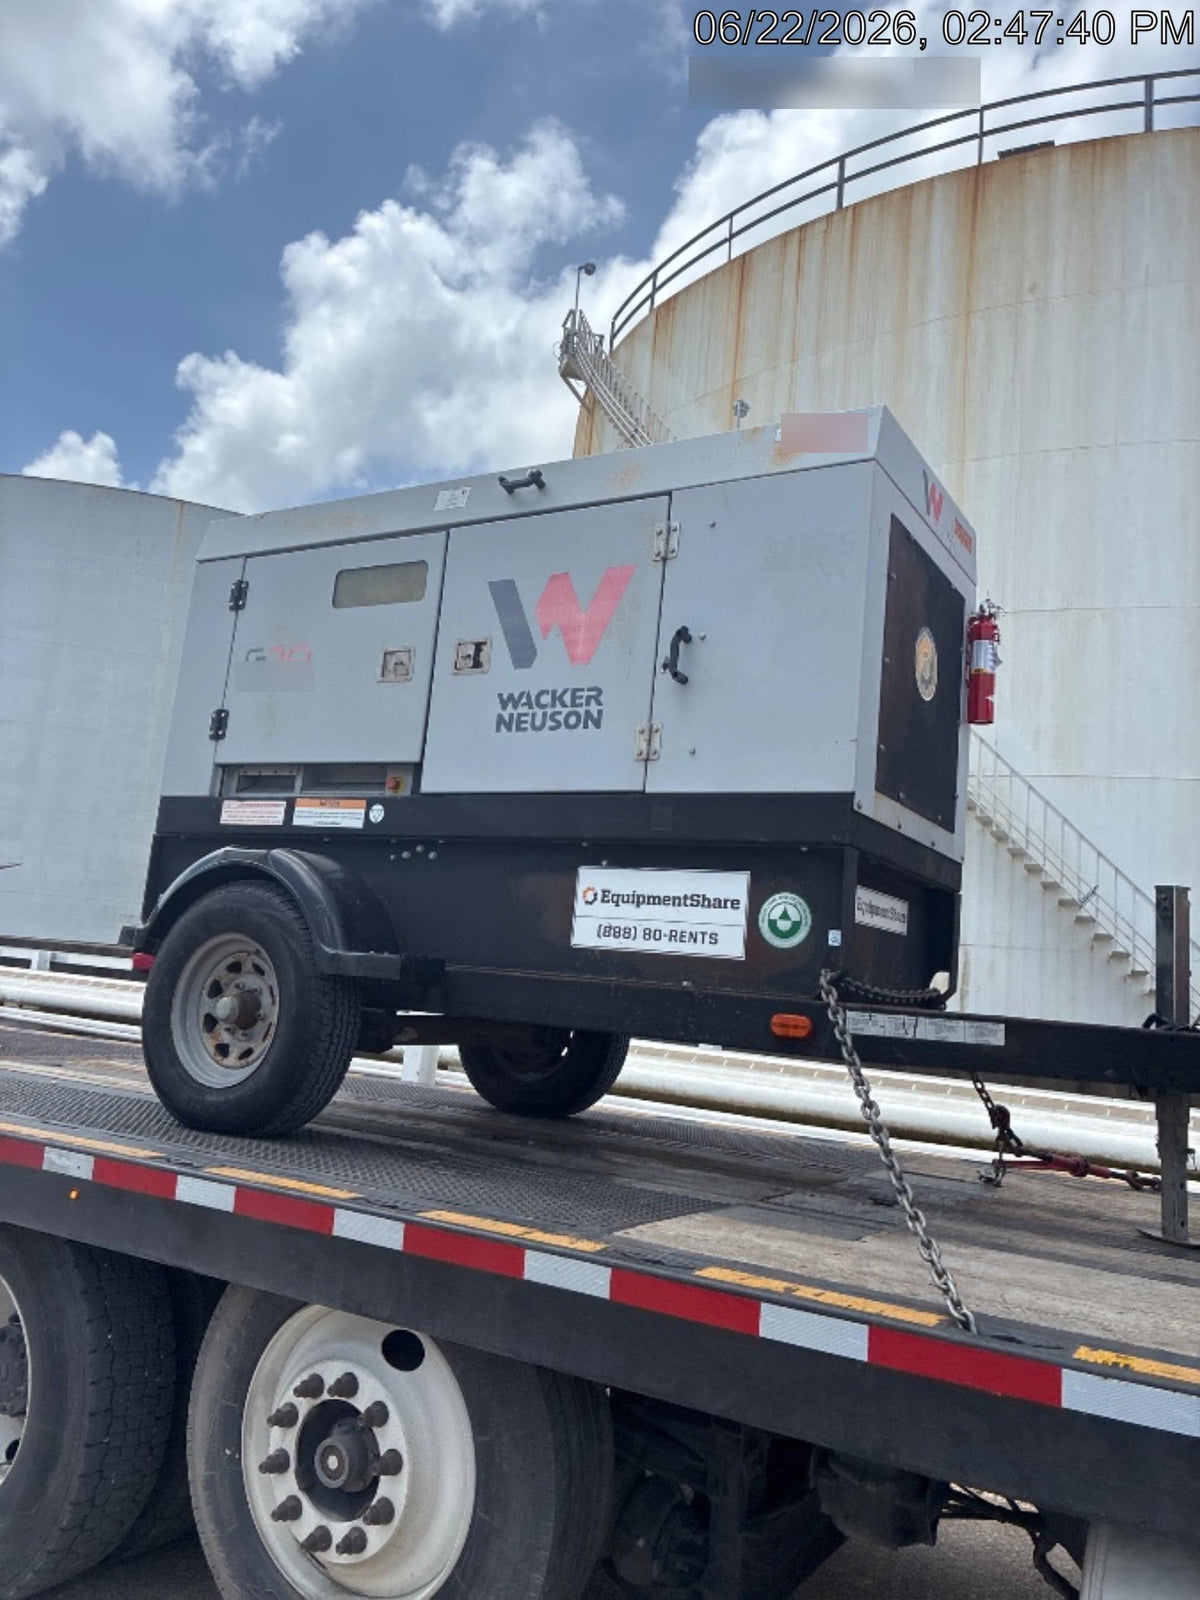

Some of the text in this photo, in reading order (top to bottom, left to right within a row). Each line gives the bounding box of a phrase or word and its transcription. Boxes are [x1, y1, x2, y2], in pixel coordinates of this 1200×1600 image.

[497, 686, 604, 711] WACKER
[495, 709, 604, 733] NEUSON
[600, 888, 741, 910] EquipmentShare
[597, 923, 719, 946] (888) 80-RENTS
